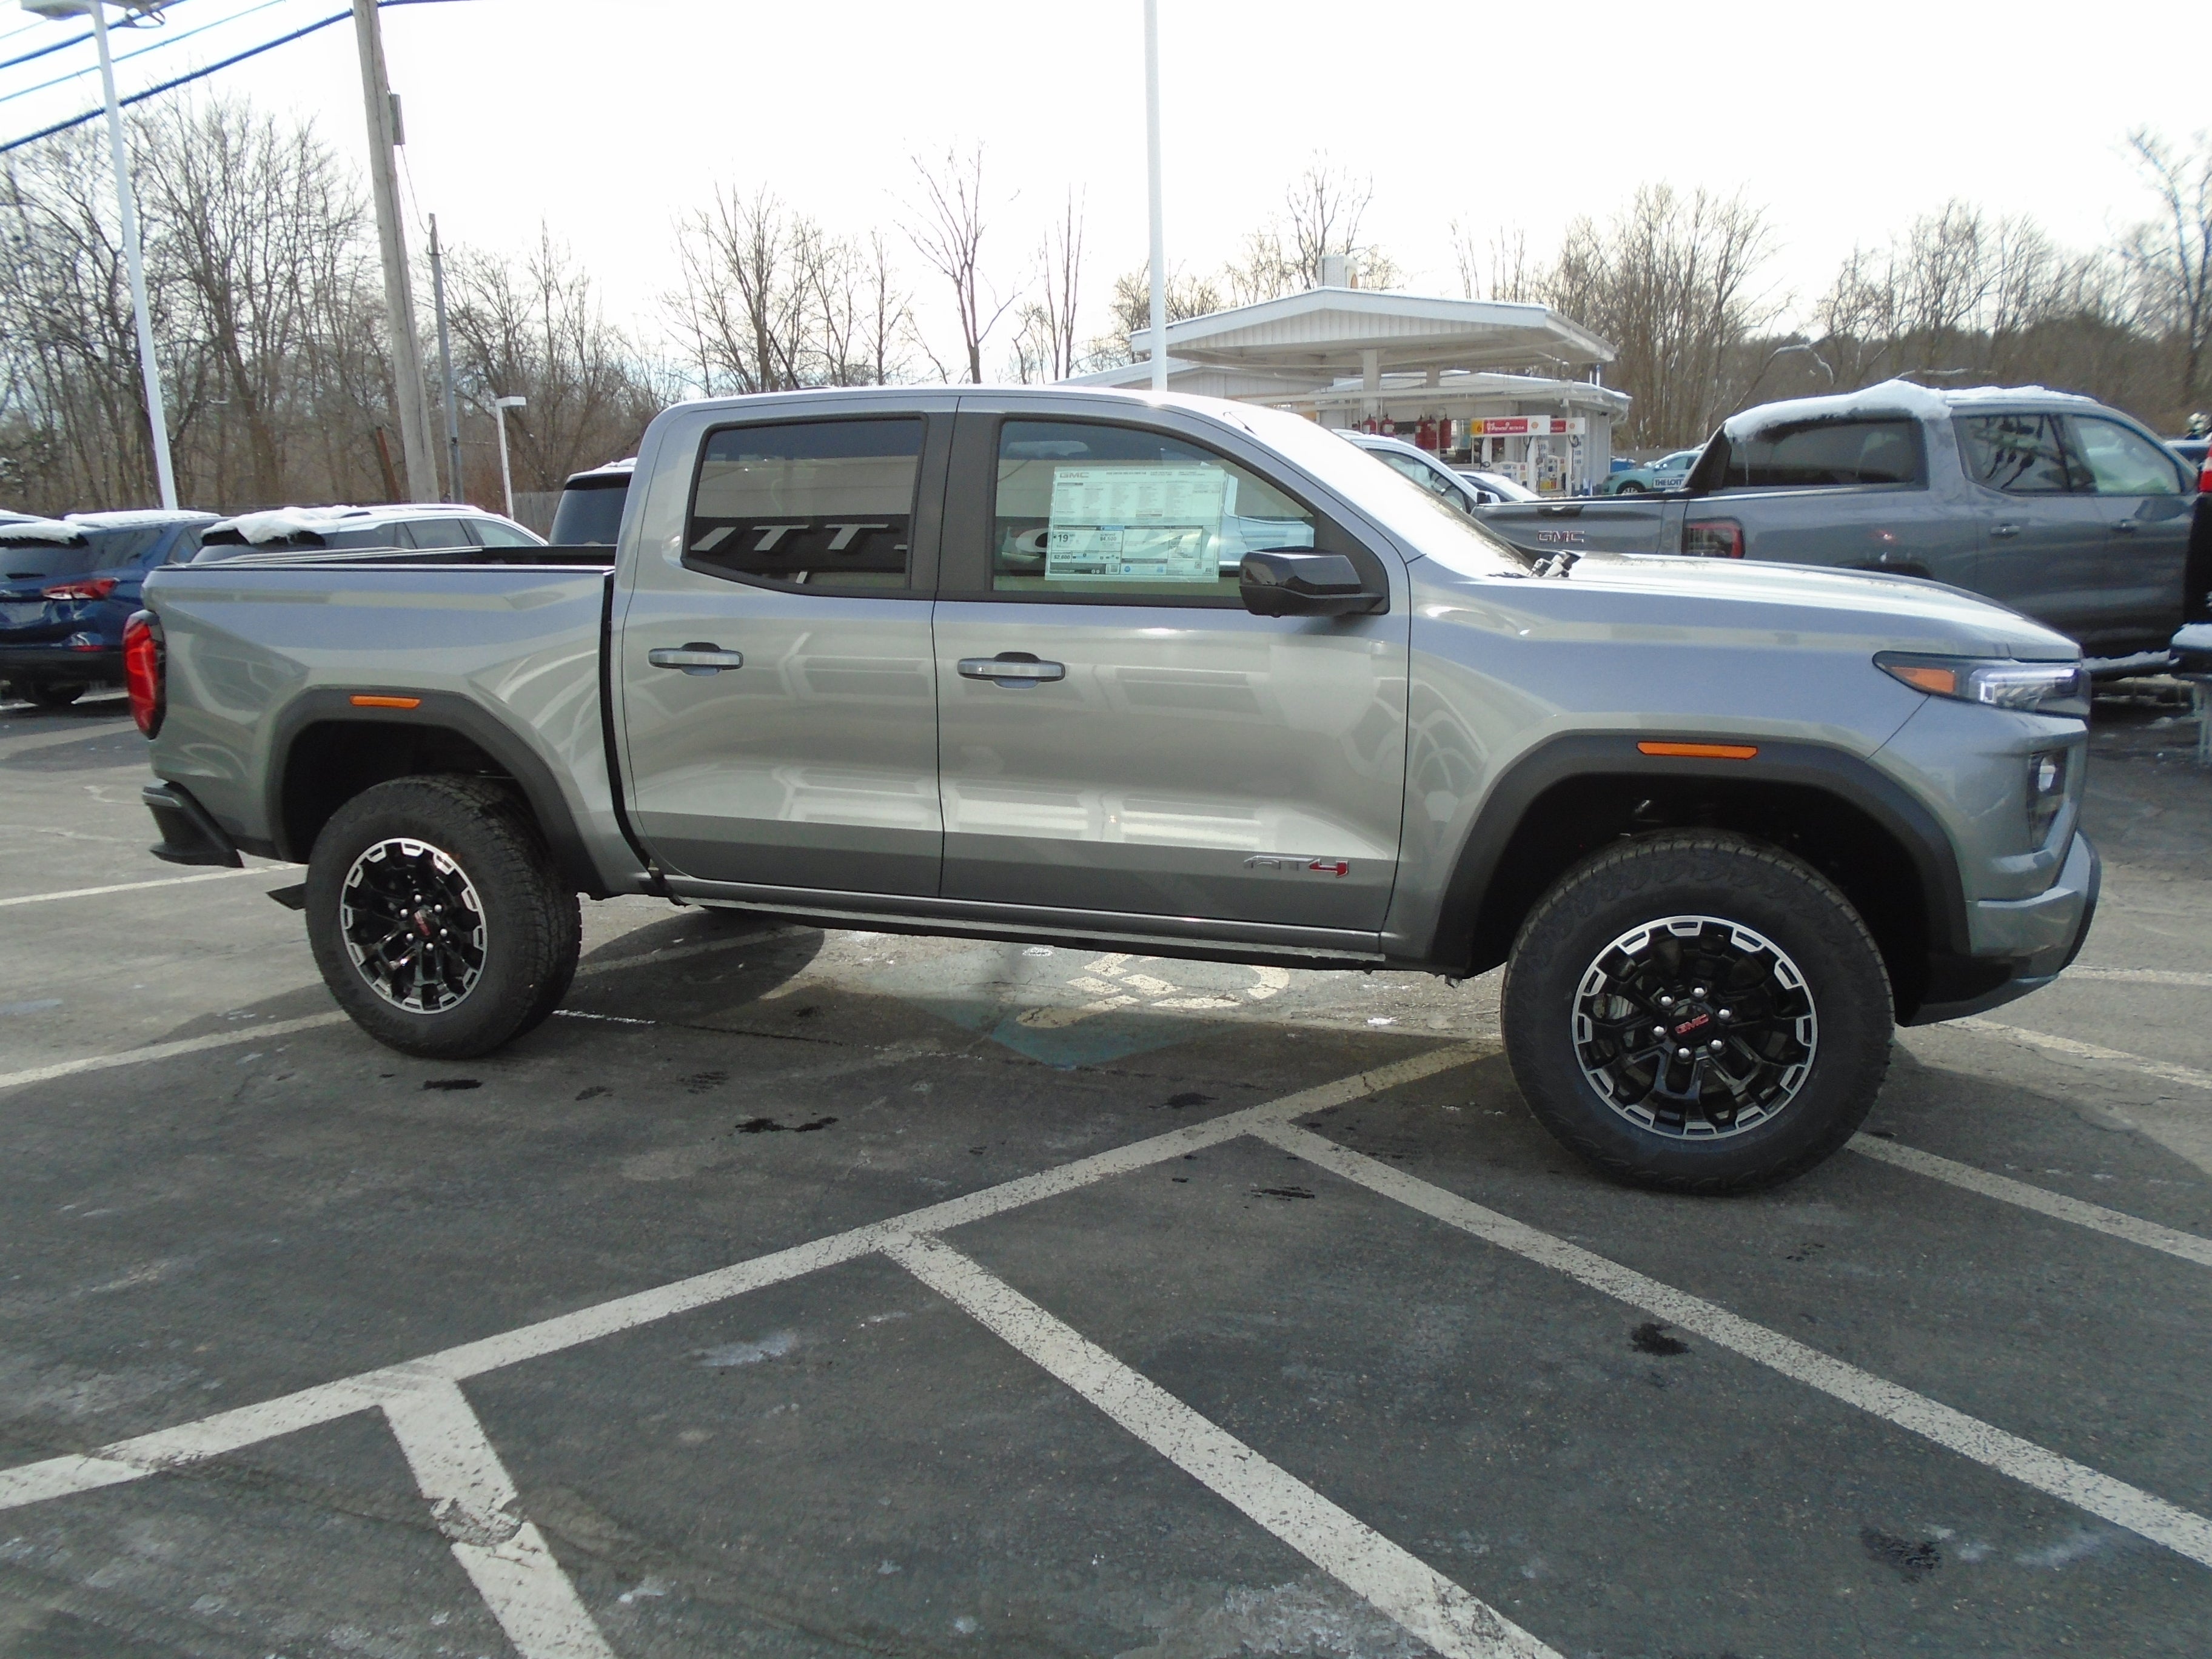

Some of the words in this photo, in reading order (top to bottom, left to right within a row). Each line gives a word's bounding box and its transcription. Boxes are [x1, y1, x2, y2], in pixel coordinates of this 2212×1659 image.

[1538, 531, 1585, 543] GMC
[1244, 855, 1348, 877] AT4
[1675, 1014, 1709, 1034] GMC
